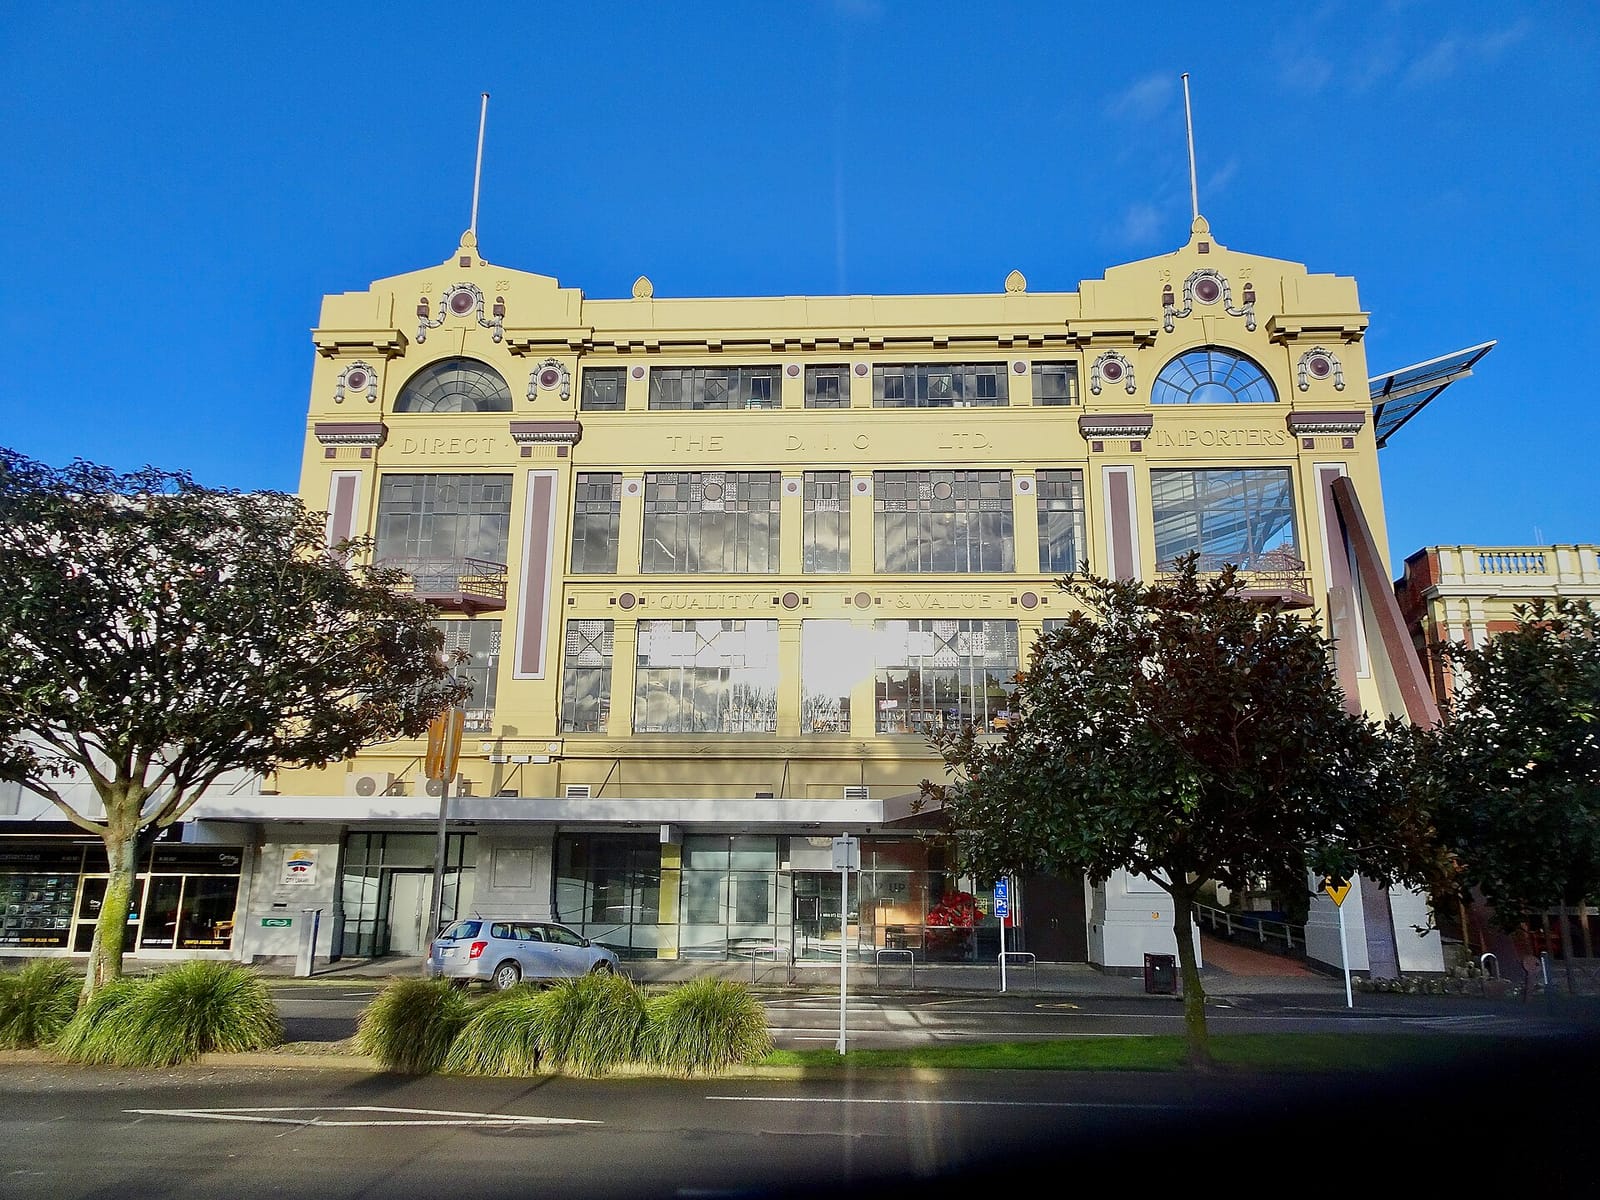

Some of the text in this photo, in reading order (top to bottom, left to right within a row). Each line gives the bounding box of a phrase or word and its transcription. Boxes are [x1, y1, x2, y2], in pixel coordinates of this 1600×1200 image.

[400, 438, 496, 455] DIRECT
[666, 435, 724, 452] THE
[1155, 429, 1286, 447] IMPORTERS
[660, 594, 759, 610] QUALITY
[913, 594, 992, 609] VALUE
